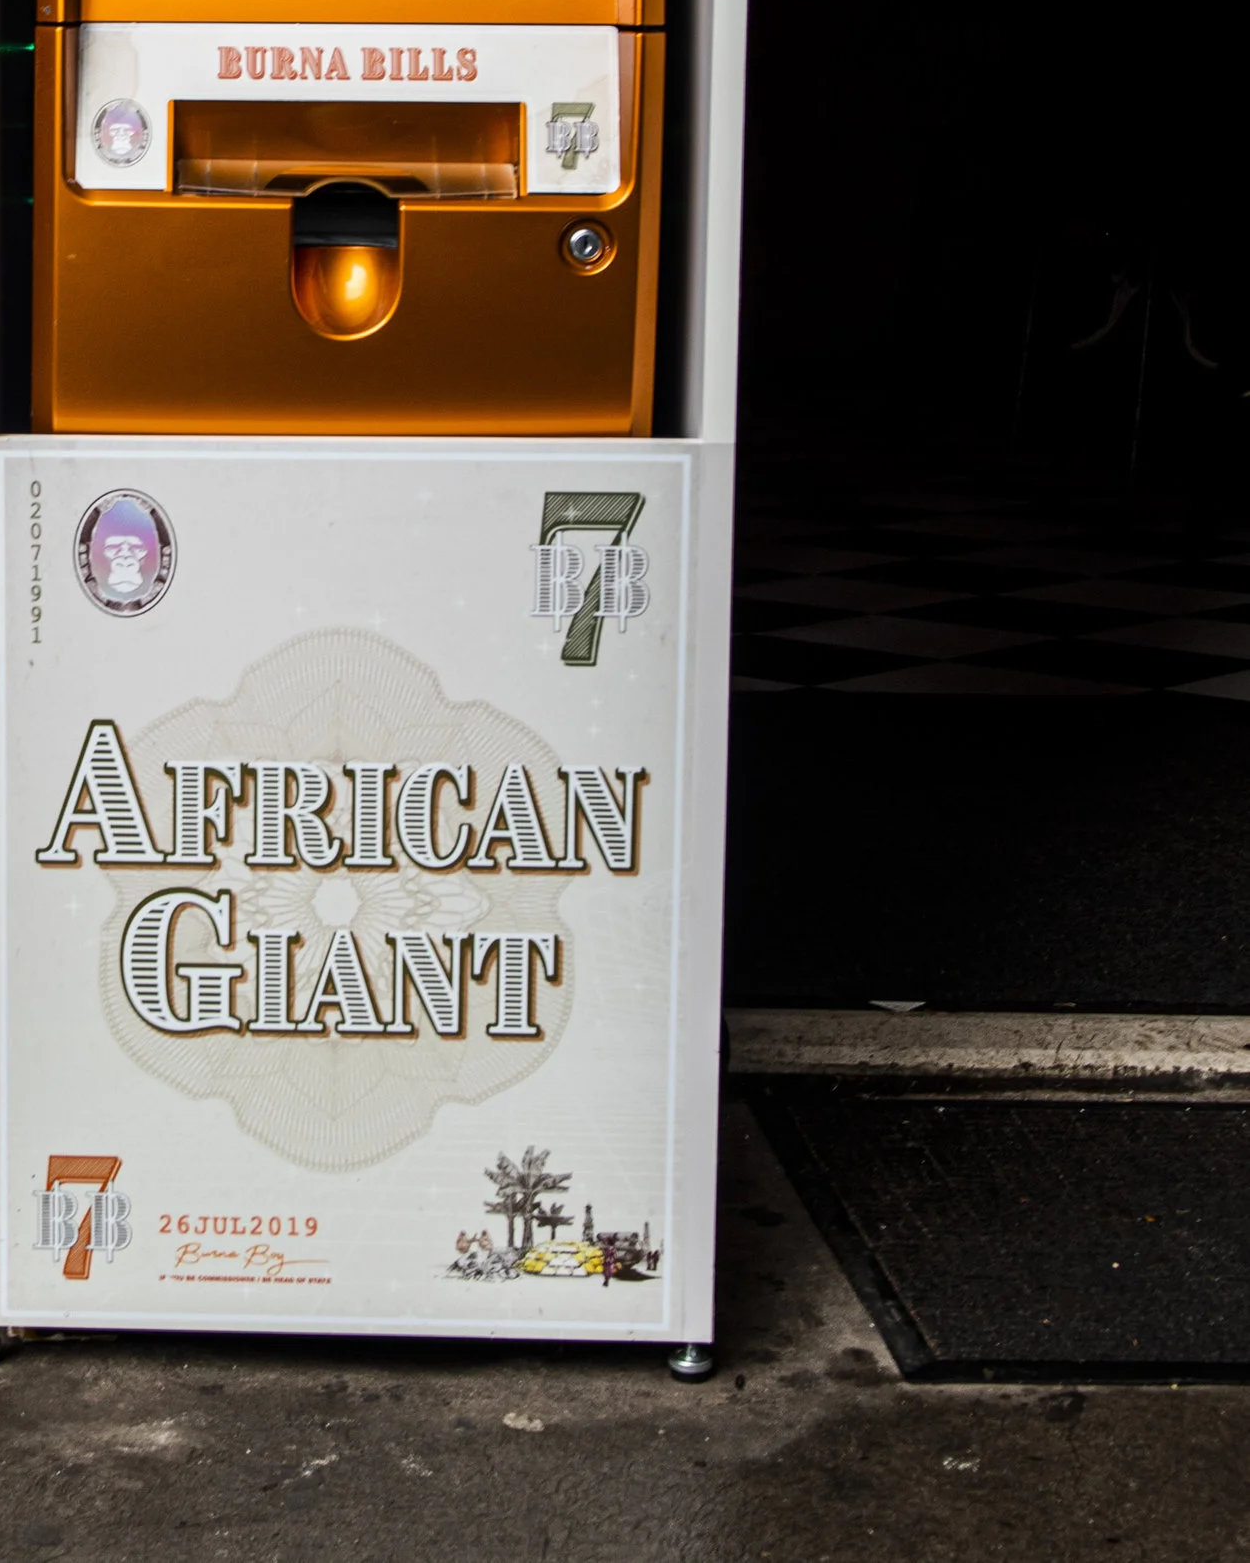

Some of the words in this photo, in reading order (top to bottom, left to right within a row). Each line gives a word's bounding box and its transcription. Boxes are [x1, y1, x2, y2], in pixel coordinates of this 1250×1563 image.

[217, 46, 350, 81] BURNA
[360, 47, 480, 83] BILLS
[35, 718, 648, 877] AFRICAN
[119, 885, 564, 1043] GIANT
[159, 1214, 319, 1238] 26JUL2019
[243, 1242, 330, 1276] Boy
